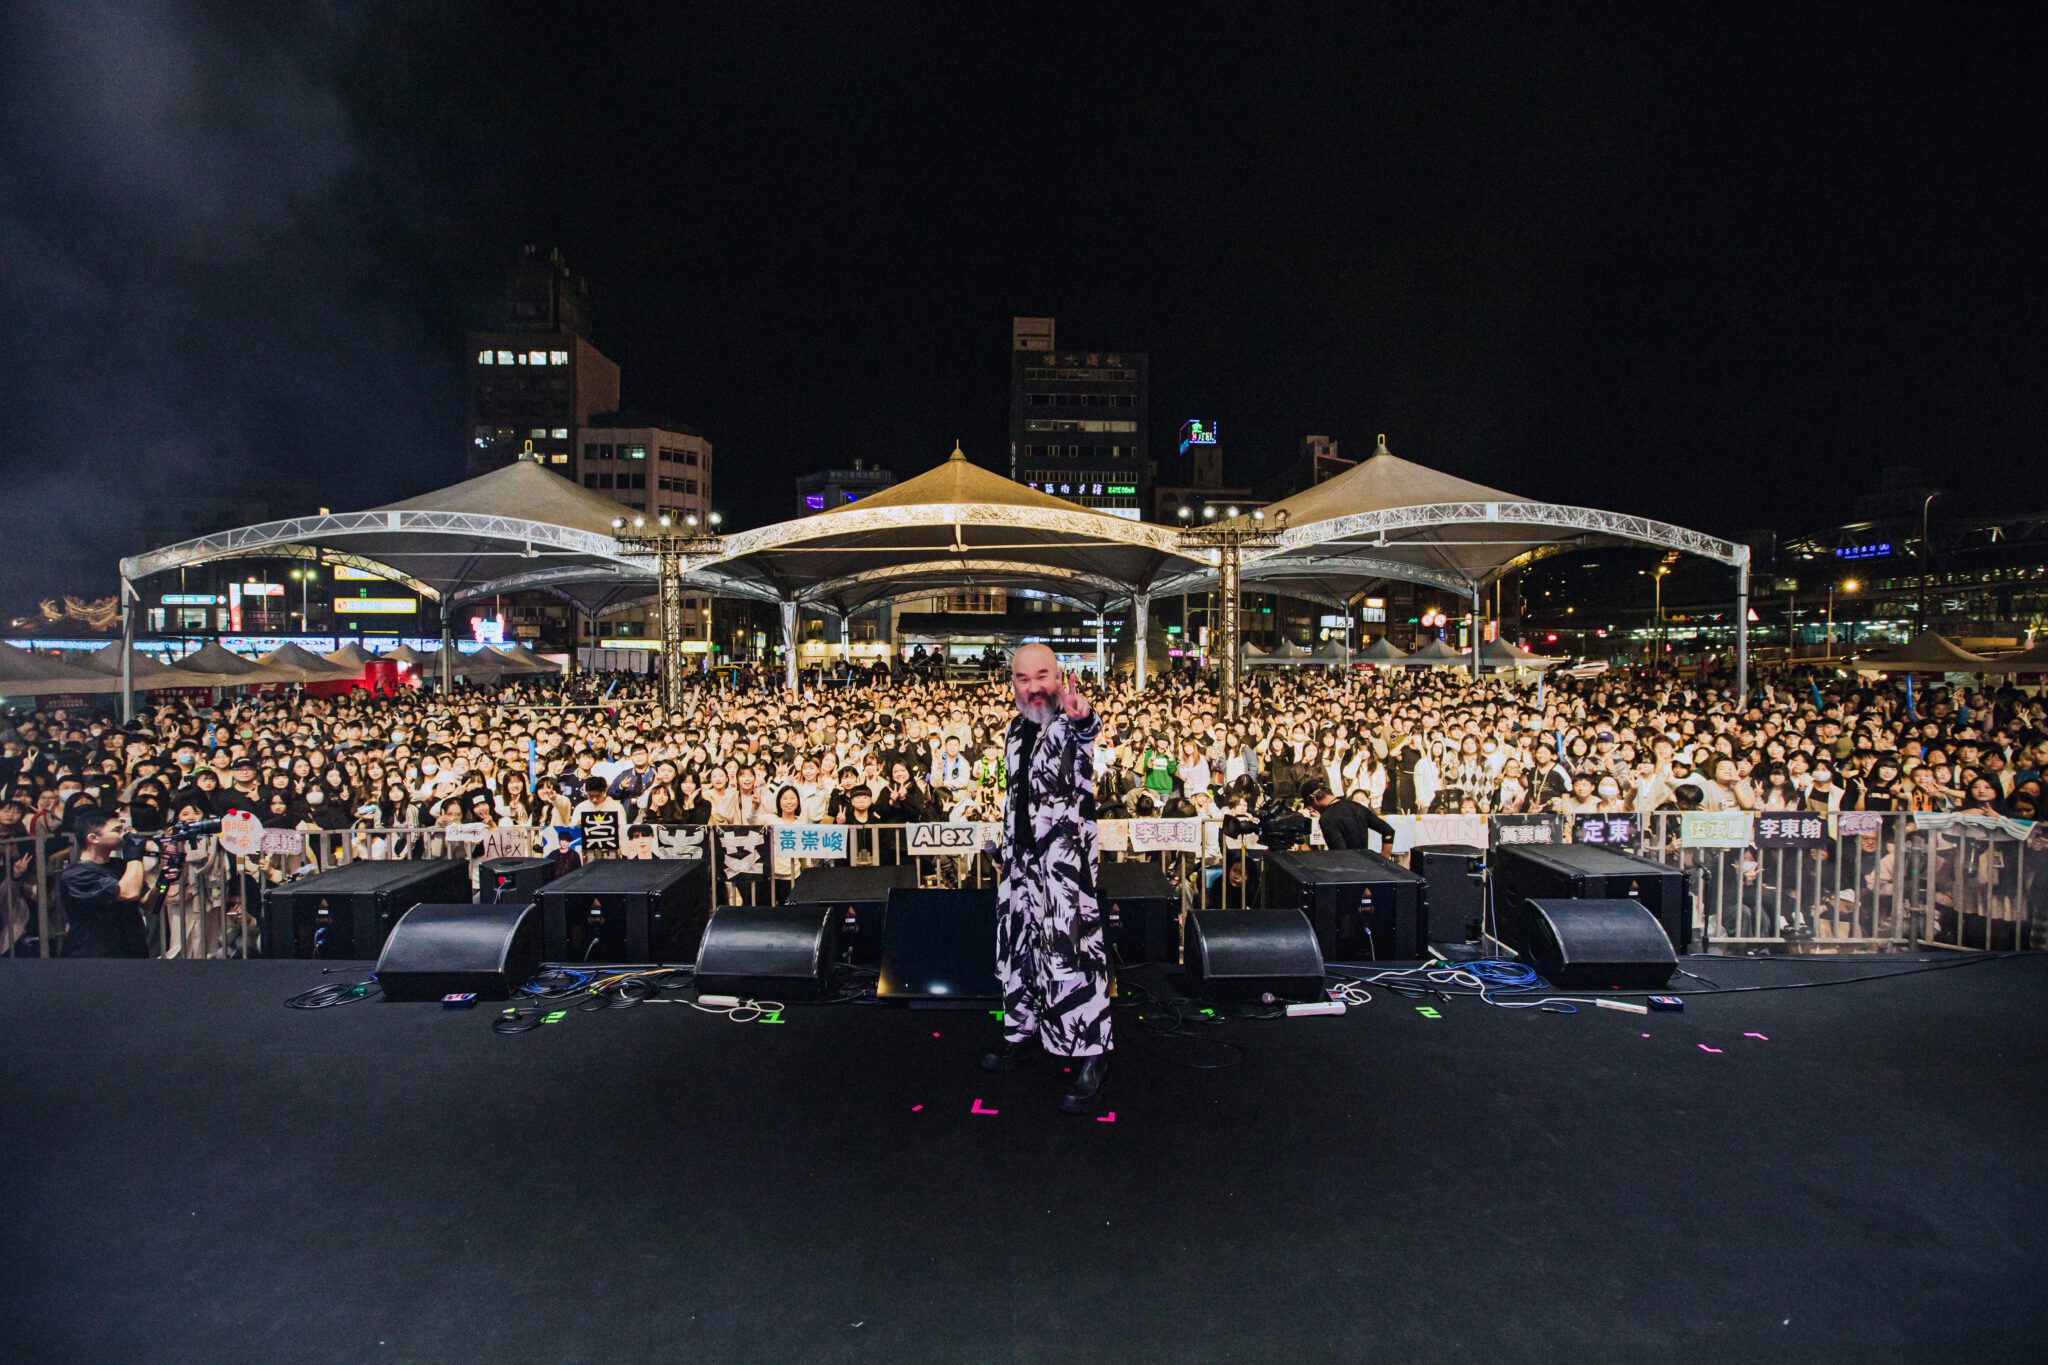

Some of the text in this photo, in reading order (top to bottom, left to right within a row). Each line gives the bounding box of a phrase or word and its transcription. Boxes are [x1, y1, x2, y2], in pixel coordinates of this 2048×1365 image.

[912, 824, 973, 848] Alex
[1135, 821, 1197, 843] 李東翰
[1582, 819, 1630, 843] 定東
[1759, 818, 1822, 839] 李東翰
[486, 833, 521, 858] Alex
[779, 829, 844, 852] 黃崇峻
